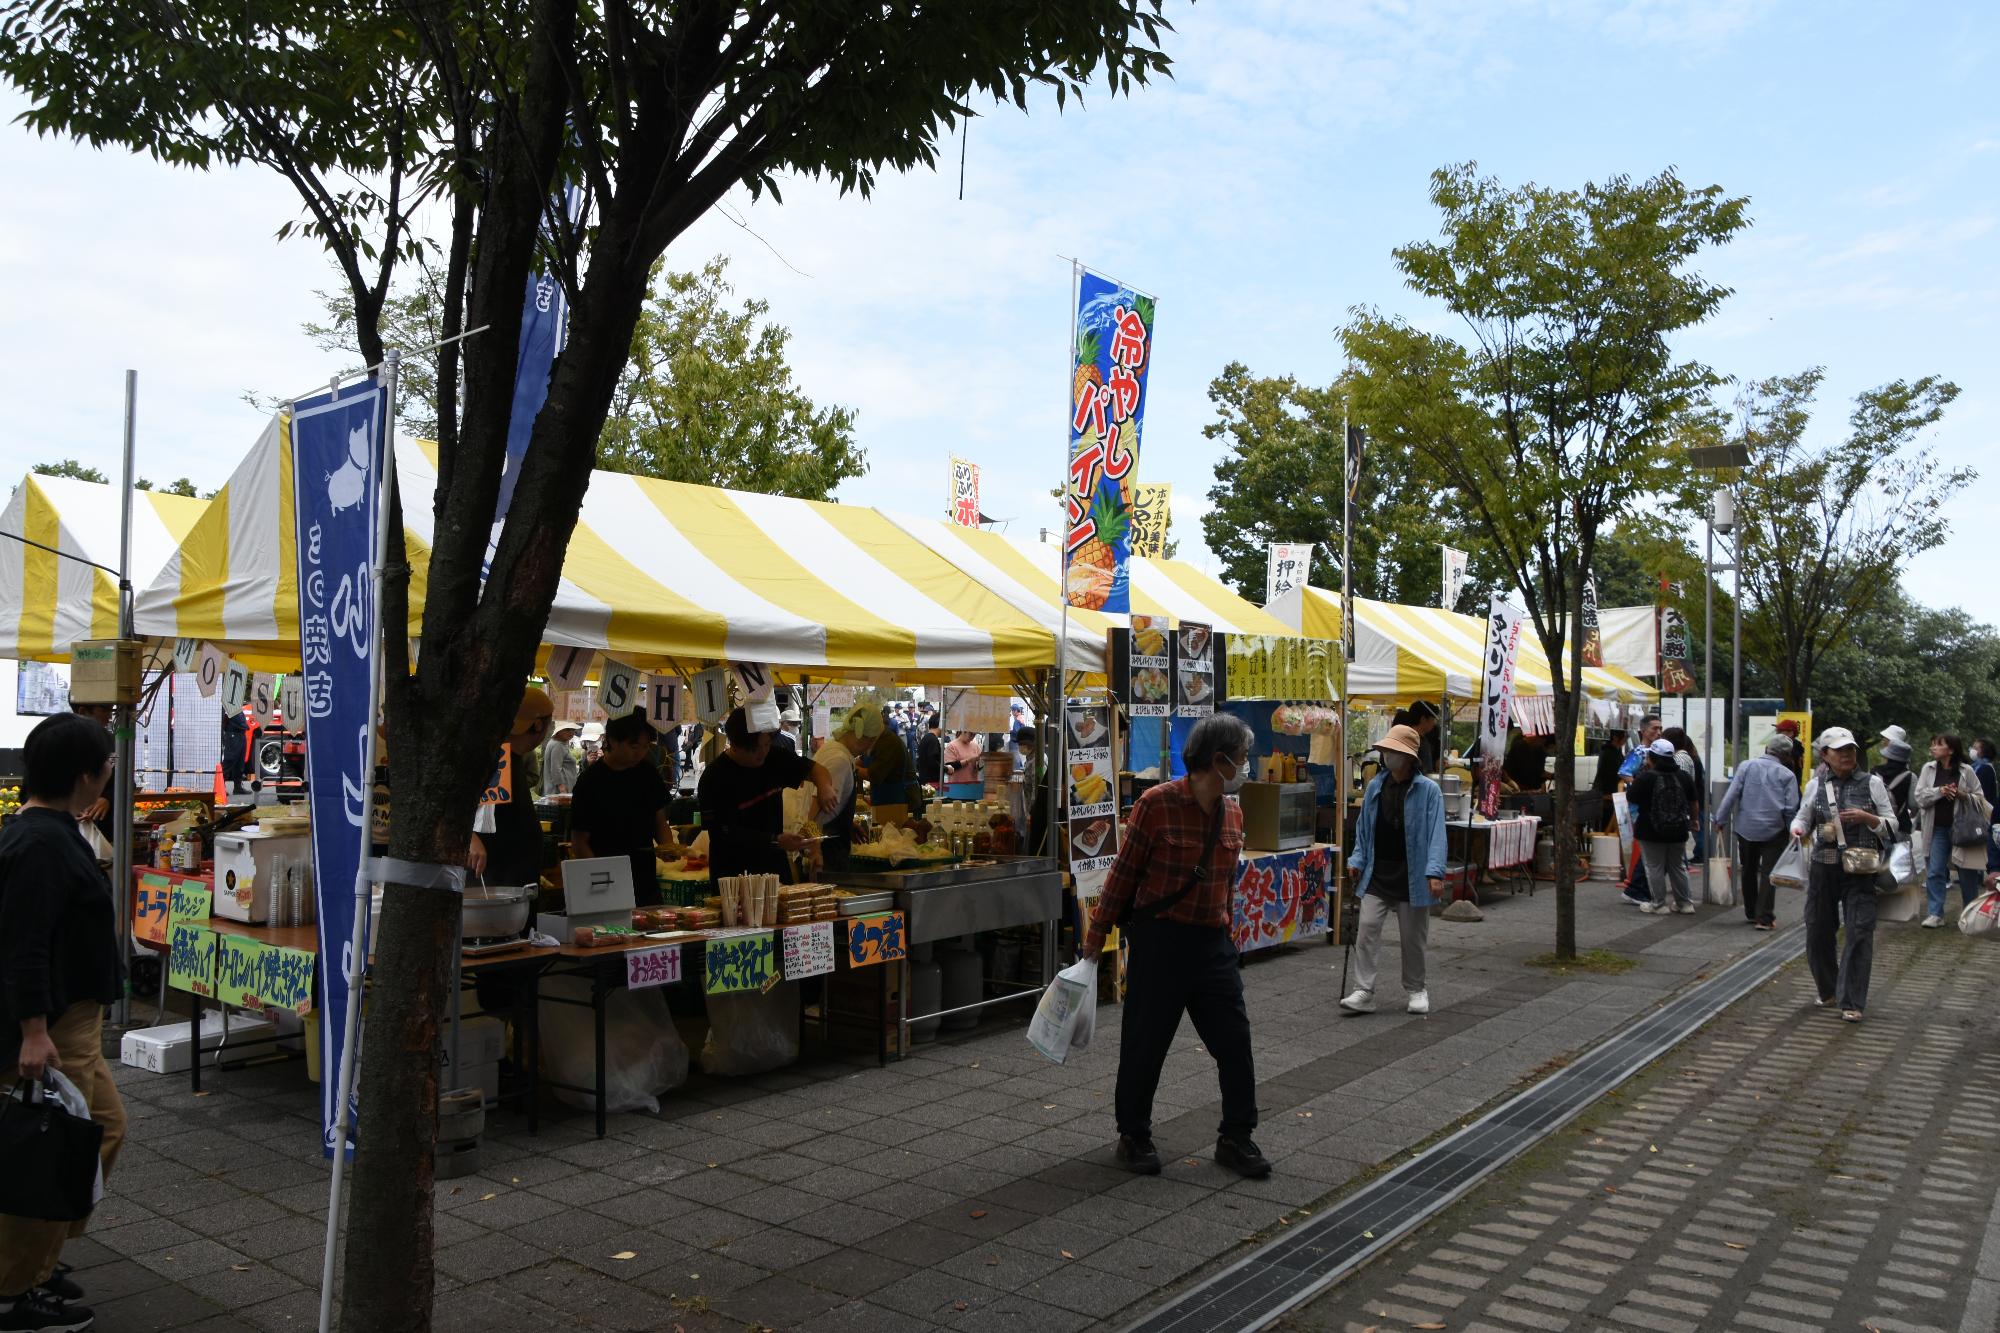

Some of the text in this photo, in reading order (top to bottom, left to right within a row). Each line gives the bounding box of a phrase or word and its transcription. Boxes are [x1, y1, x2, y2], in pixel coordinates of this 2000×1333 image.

[1109, 304, 1147, 480] 冷やし
[1067, 378, 1111, 556] パイン
[176, 638, 298, 721] MOTSU
[559, 646, 768, 722] ISHIN
[137, 890, 168, 924] コーラ
[171, 887, 206, 916] オレンジ
[1238, 861, 1302, 943] 祭り
[170, 926, 215, 984] 緑茶ハイ
[219, 938, 264, 997] ウーロンハイ
[630, 949, 679, 984] お会計
[707, 938, 774, 991] 焼きそば
[849, 914, 907, 964] もつ煮
